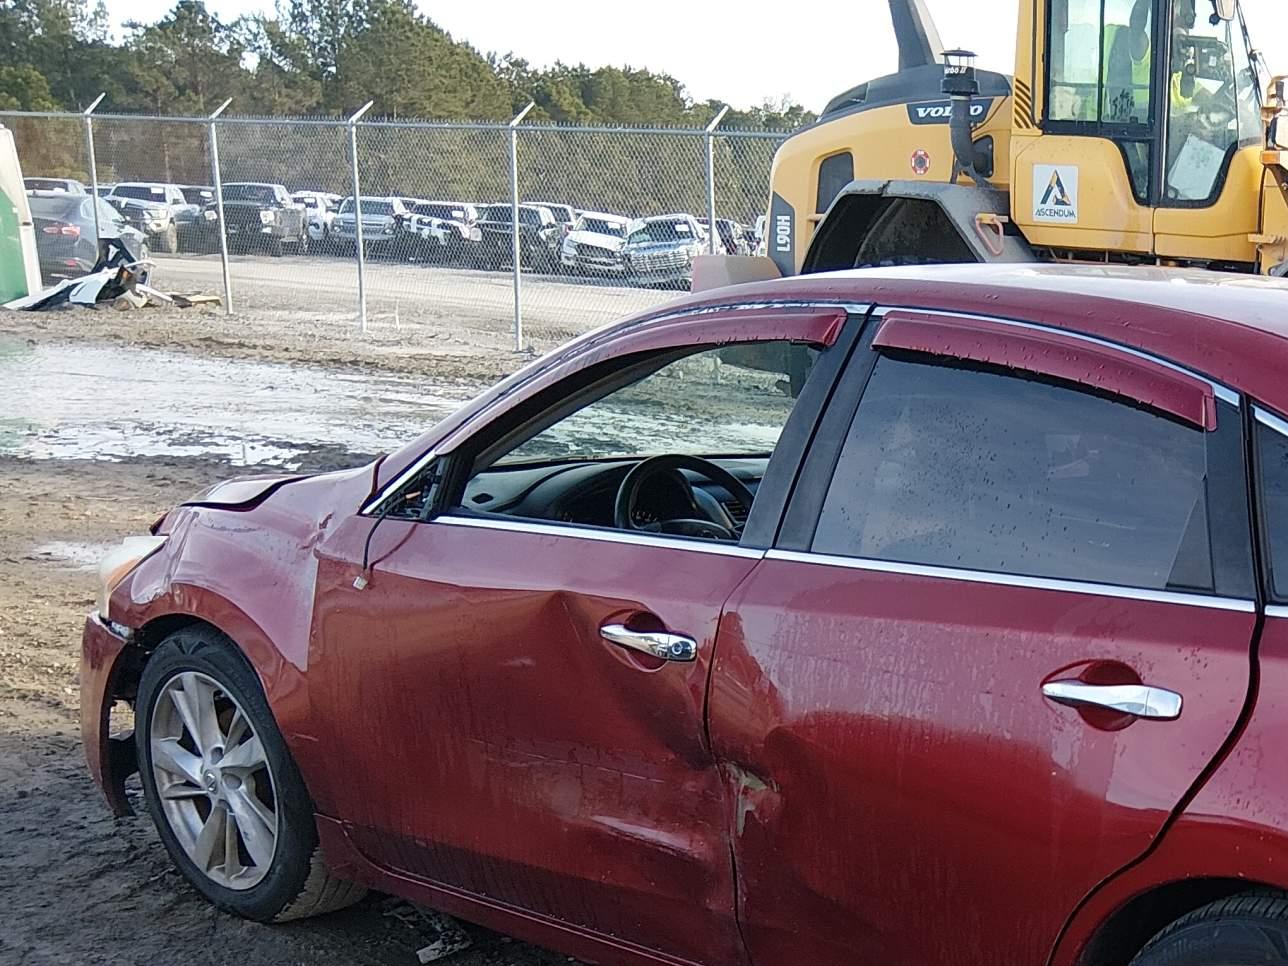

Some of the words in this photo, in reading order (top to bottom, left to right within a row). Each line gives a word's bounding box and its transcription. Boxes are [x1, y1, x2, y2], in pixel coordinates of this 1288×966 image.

[916, 104, 983, 118] VOLO
[1035, 208, 1076, 219] ASCENDUM
[776, 215, 791, 252] L90H
